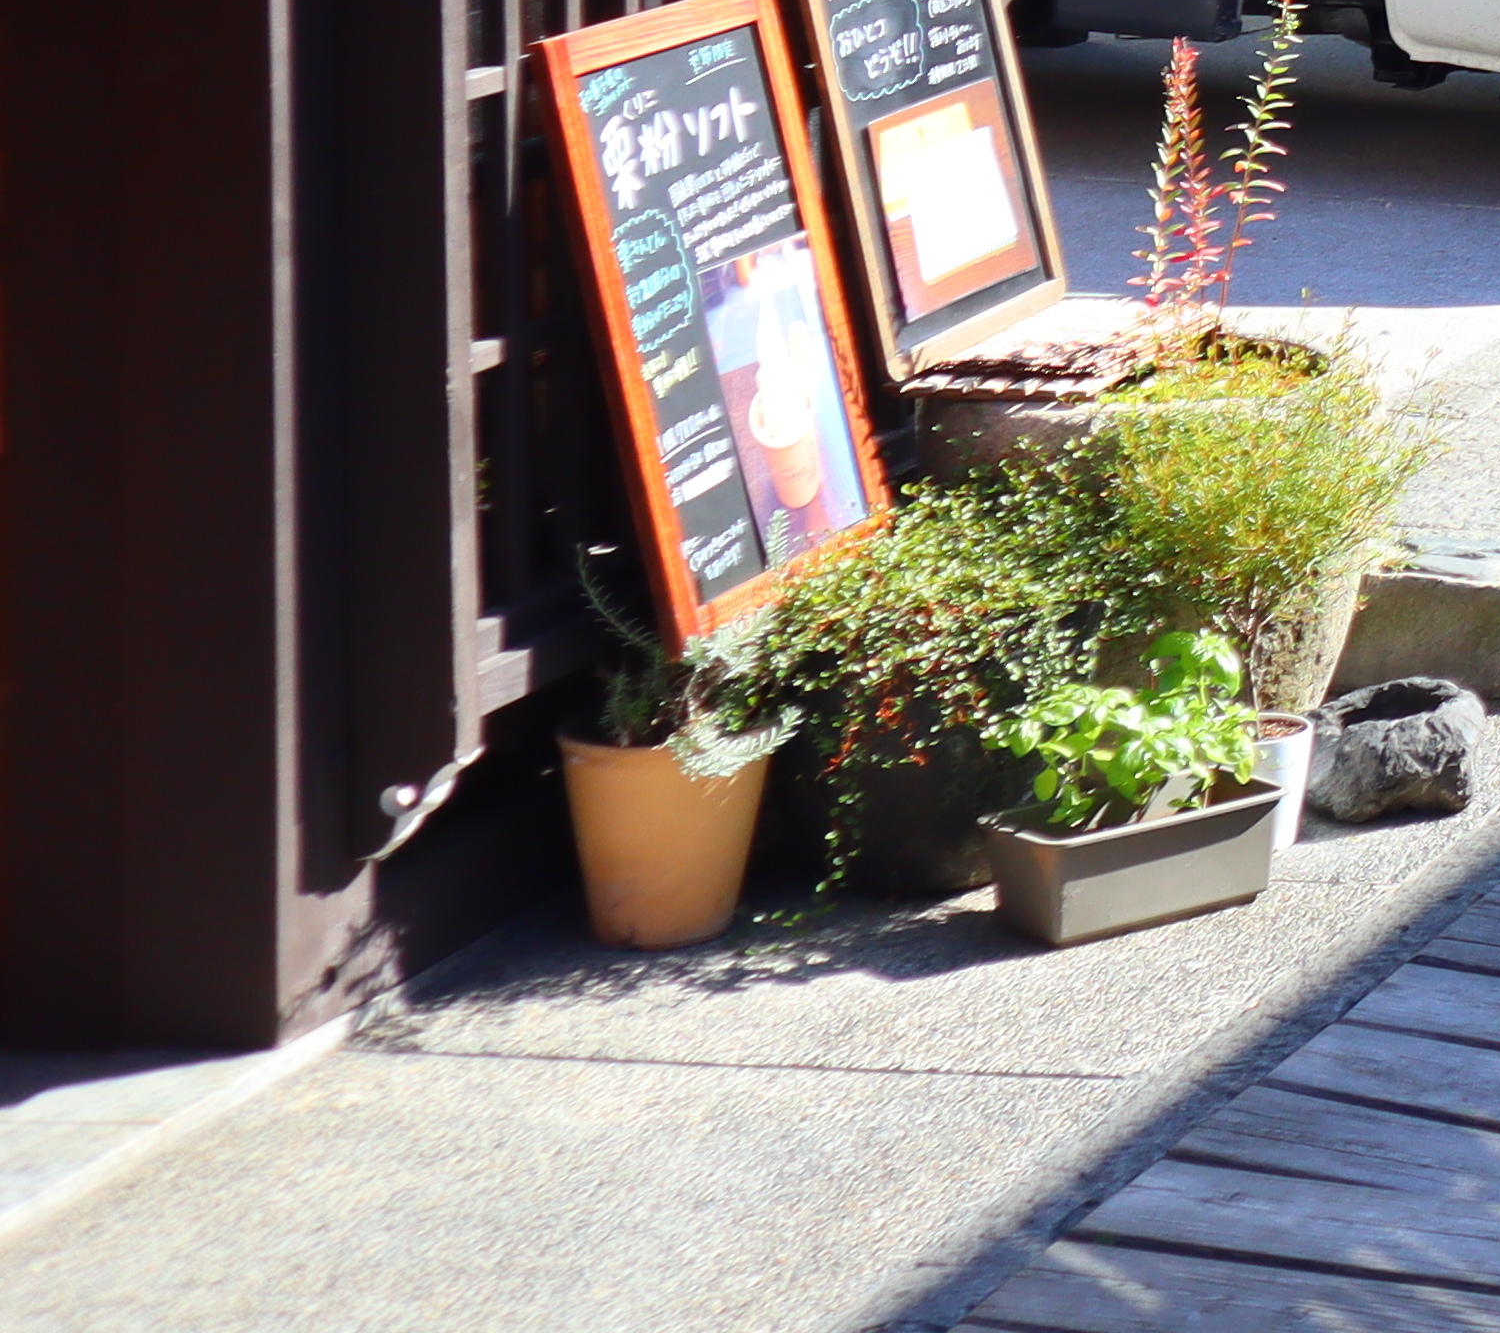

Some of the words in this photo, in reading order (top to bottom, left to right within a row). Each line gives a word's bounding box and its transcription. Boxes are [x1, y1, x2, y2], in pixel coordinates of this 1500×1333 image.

[836, 18, 887, 59] おひとつ
[600, 85, 760, 211] 栗粉ソフト
